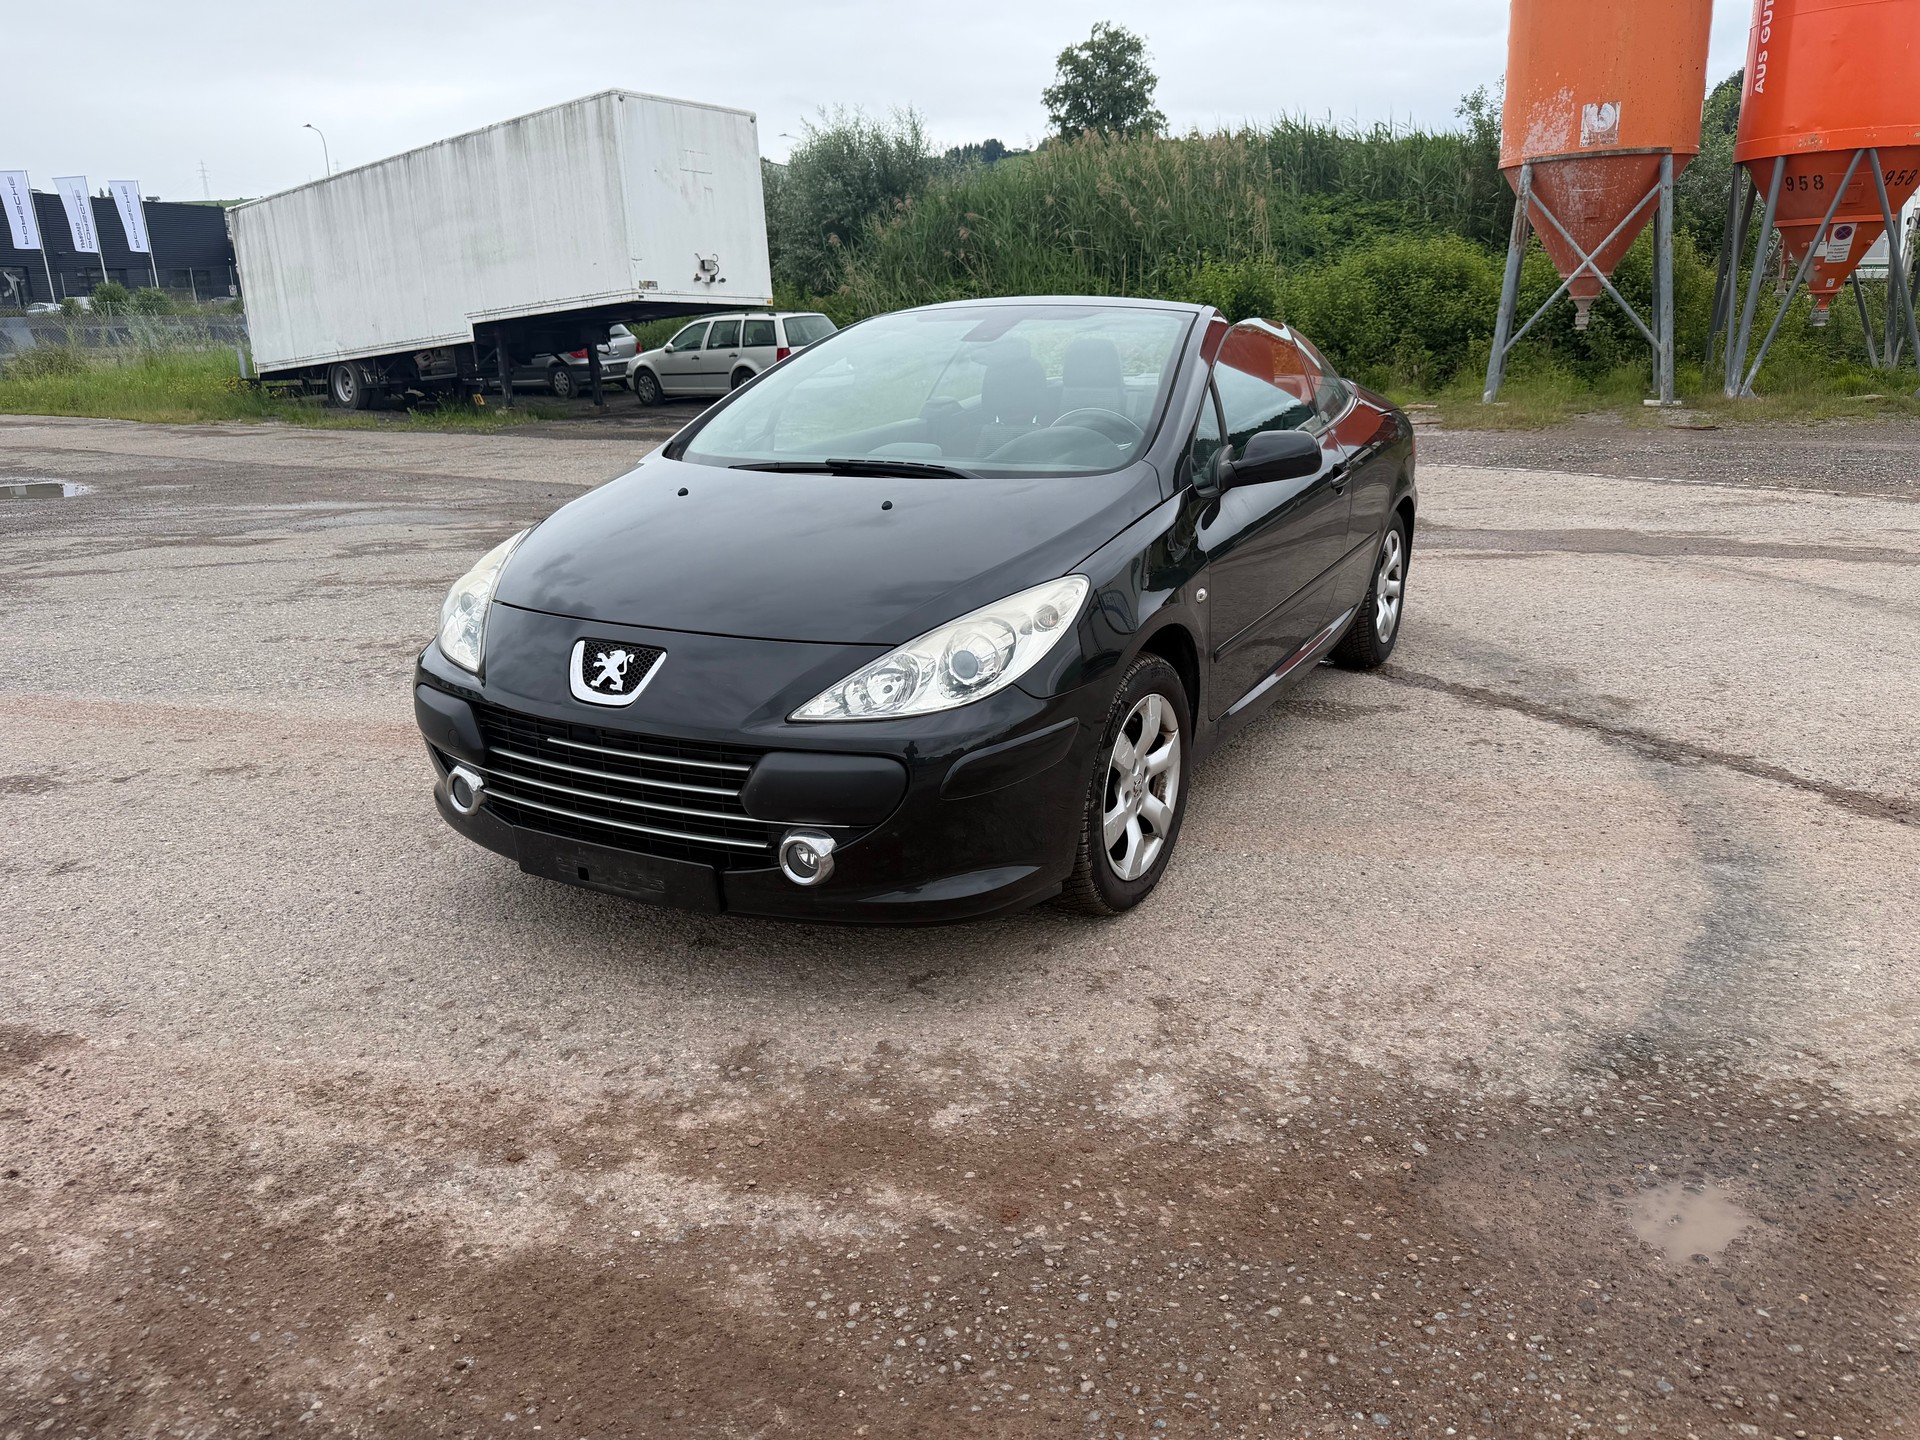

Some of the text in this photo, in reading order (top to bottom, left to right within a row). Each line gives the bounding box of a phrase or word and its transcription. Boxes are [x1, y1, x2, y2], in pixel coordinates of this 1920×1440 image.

[1755, 50, 1768, 94] AUS
[1785, 174, 1824, 192] 958
[1884, 169, 1918, 187] 958
